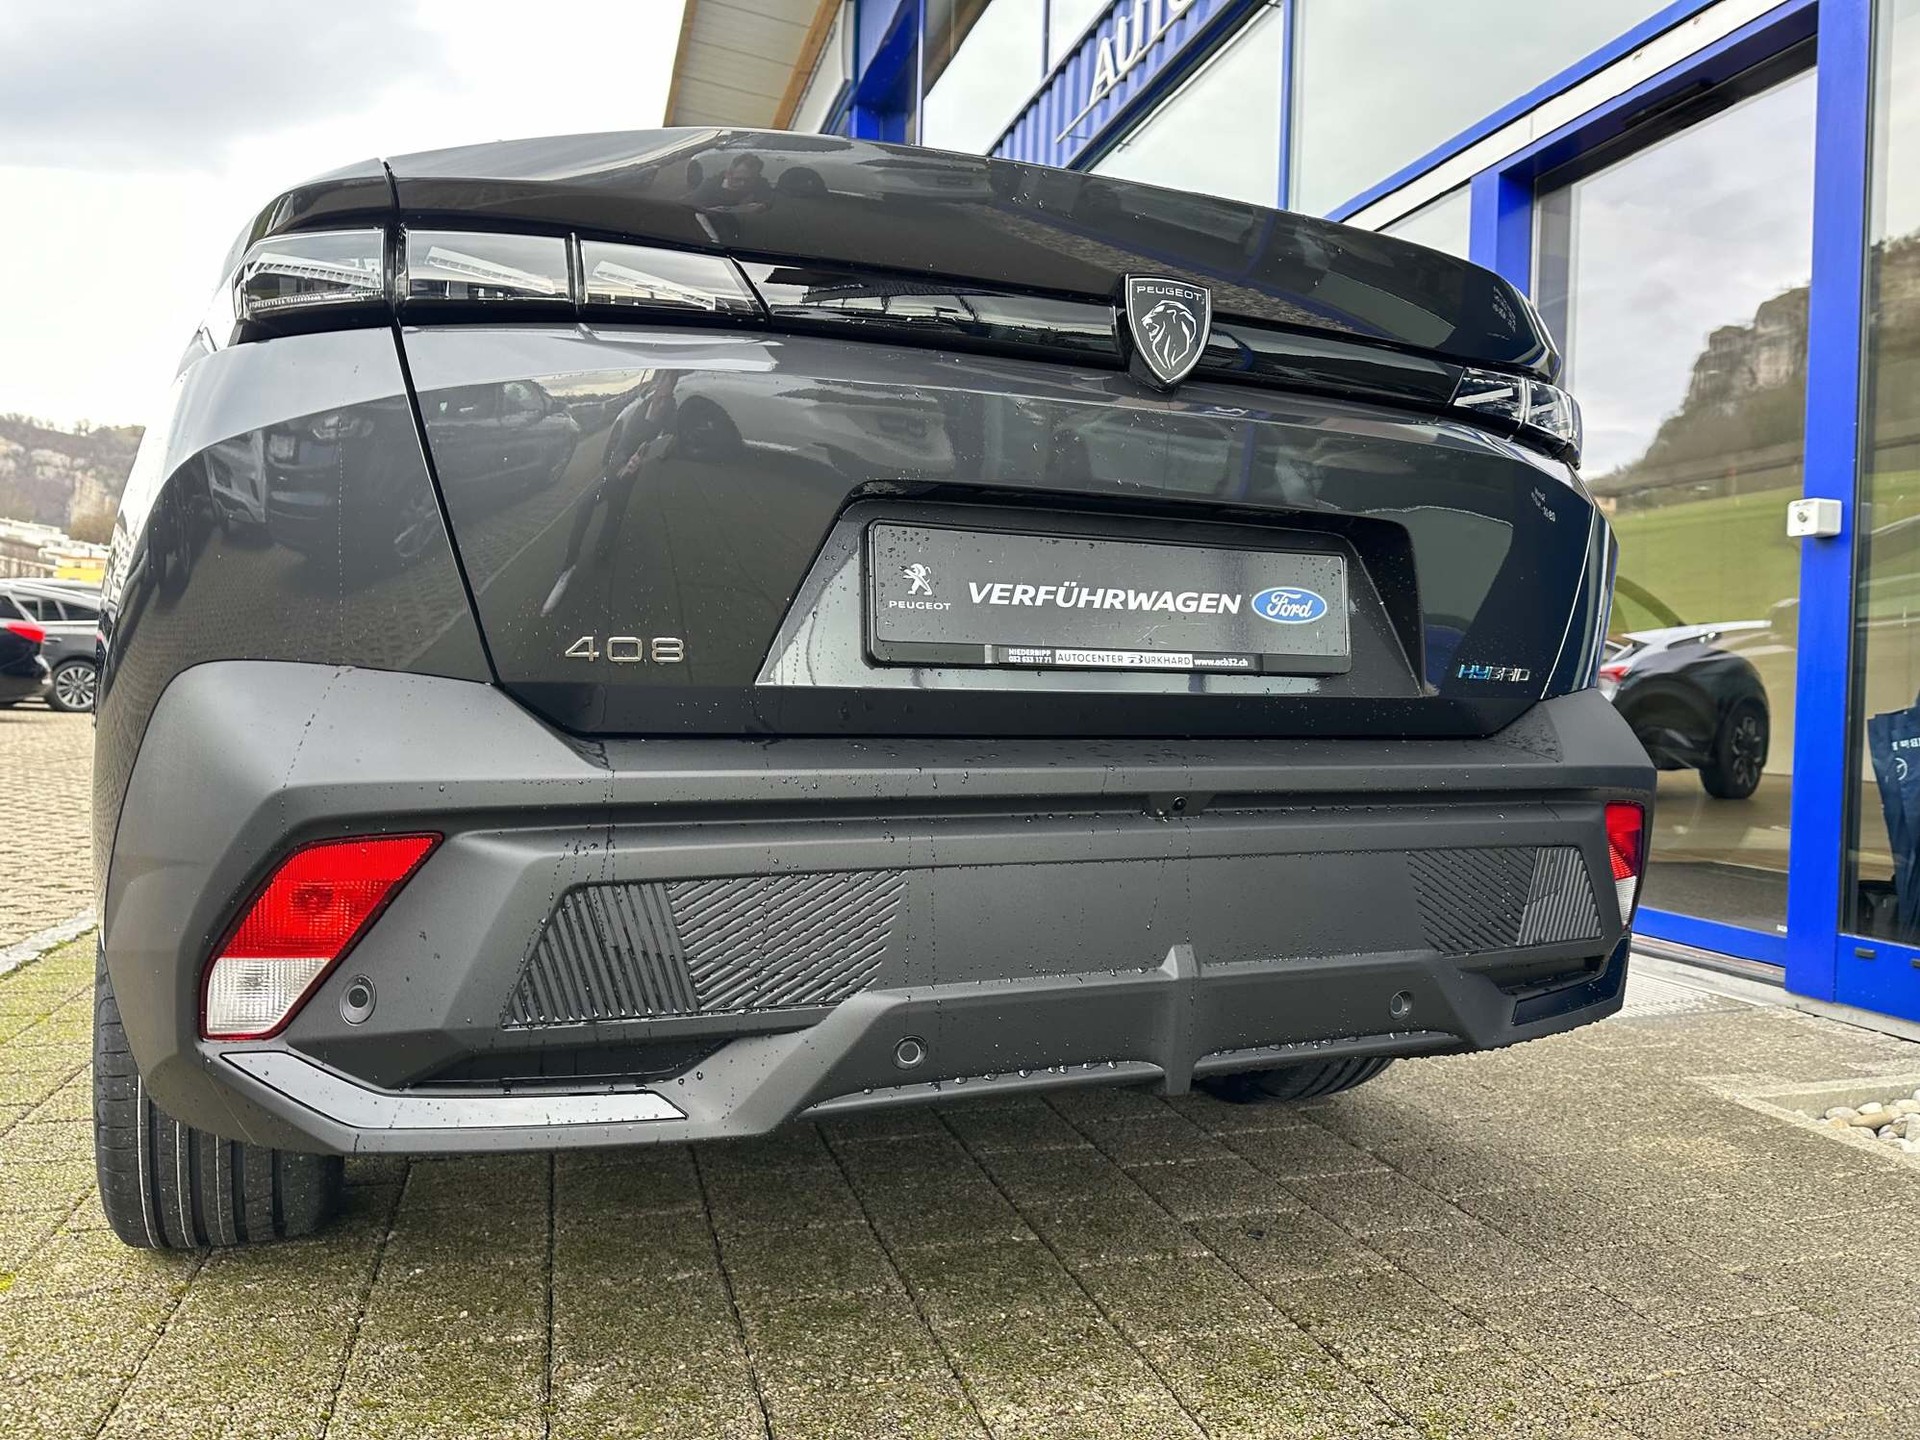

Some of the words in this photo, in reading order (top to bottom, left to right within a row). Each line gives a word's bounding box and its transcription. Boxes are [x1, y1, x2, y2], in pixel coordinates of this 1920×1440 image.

[1085, 0, 1191, 107] AU
[1136, 286, 1202, 301] PEUGEOT
[889, 600, 951, 610] PEUGEOT
[968, 581, 1242, 614] VERFÜHRWAGEN
[1266, 591, 1313, 617] Ford
[565, 636, 684, 662] 408
[1057, 653, 1124, 663] AUTOCENTER
[1457, 664, 1531, 681] HYBRID
